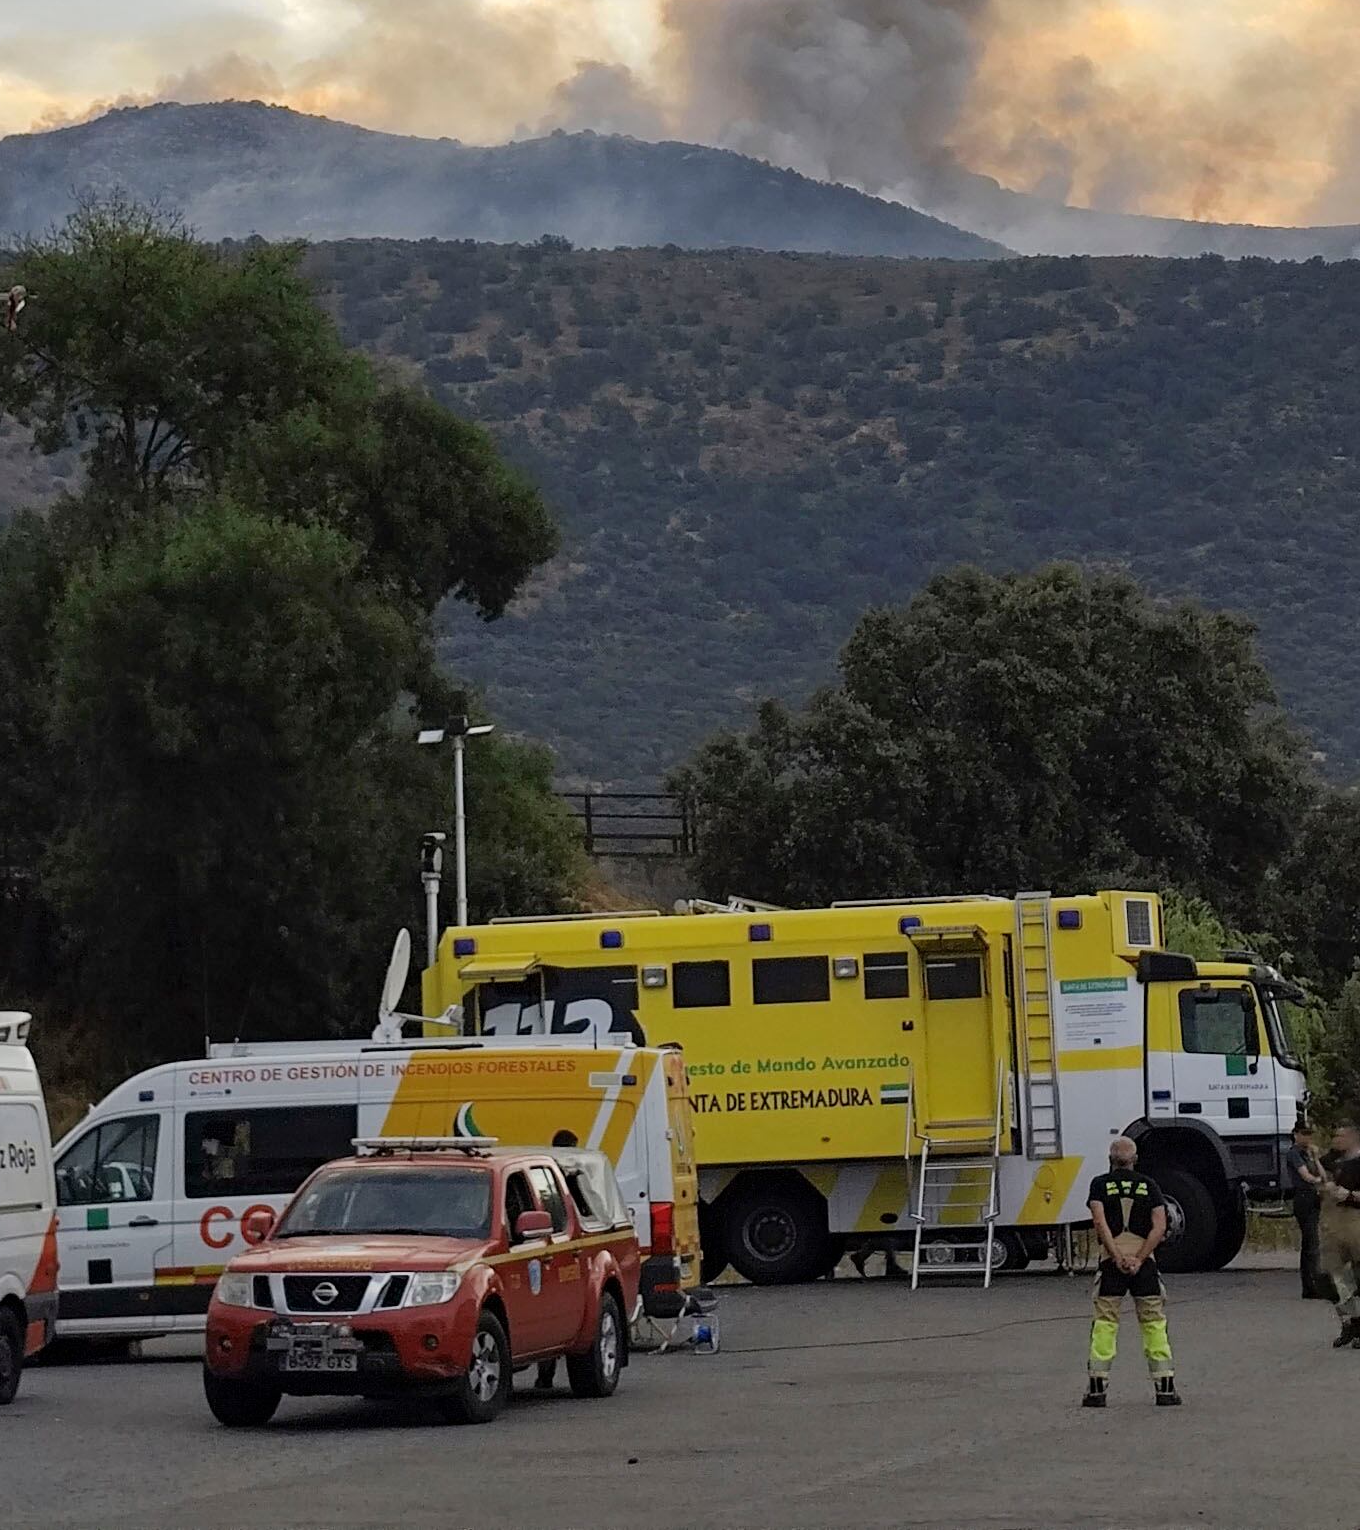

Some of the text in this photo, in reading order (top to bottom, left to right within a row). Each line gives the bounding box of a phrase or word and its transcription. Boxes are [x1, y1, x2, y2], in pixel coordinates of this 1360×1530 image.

[483, 998, 614, 1036] 112
[188, 1069, 256, 1085] CENTRO
[260, 1068, 282, 1082] DE
[363, 1064, 385, 1078] DE
[391, 1062, 473, 1076] INCENDIOS
[477, 1060, 576, 1074] FORESTALES
[685, 1053, 910, 1077] esto de Mando Avanzado
[690, 1087, 874, 1113] NTA DE EXTREMADURA
[8, 1140, 37, 1174] Roja
